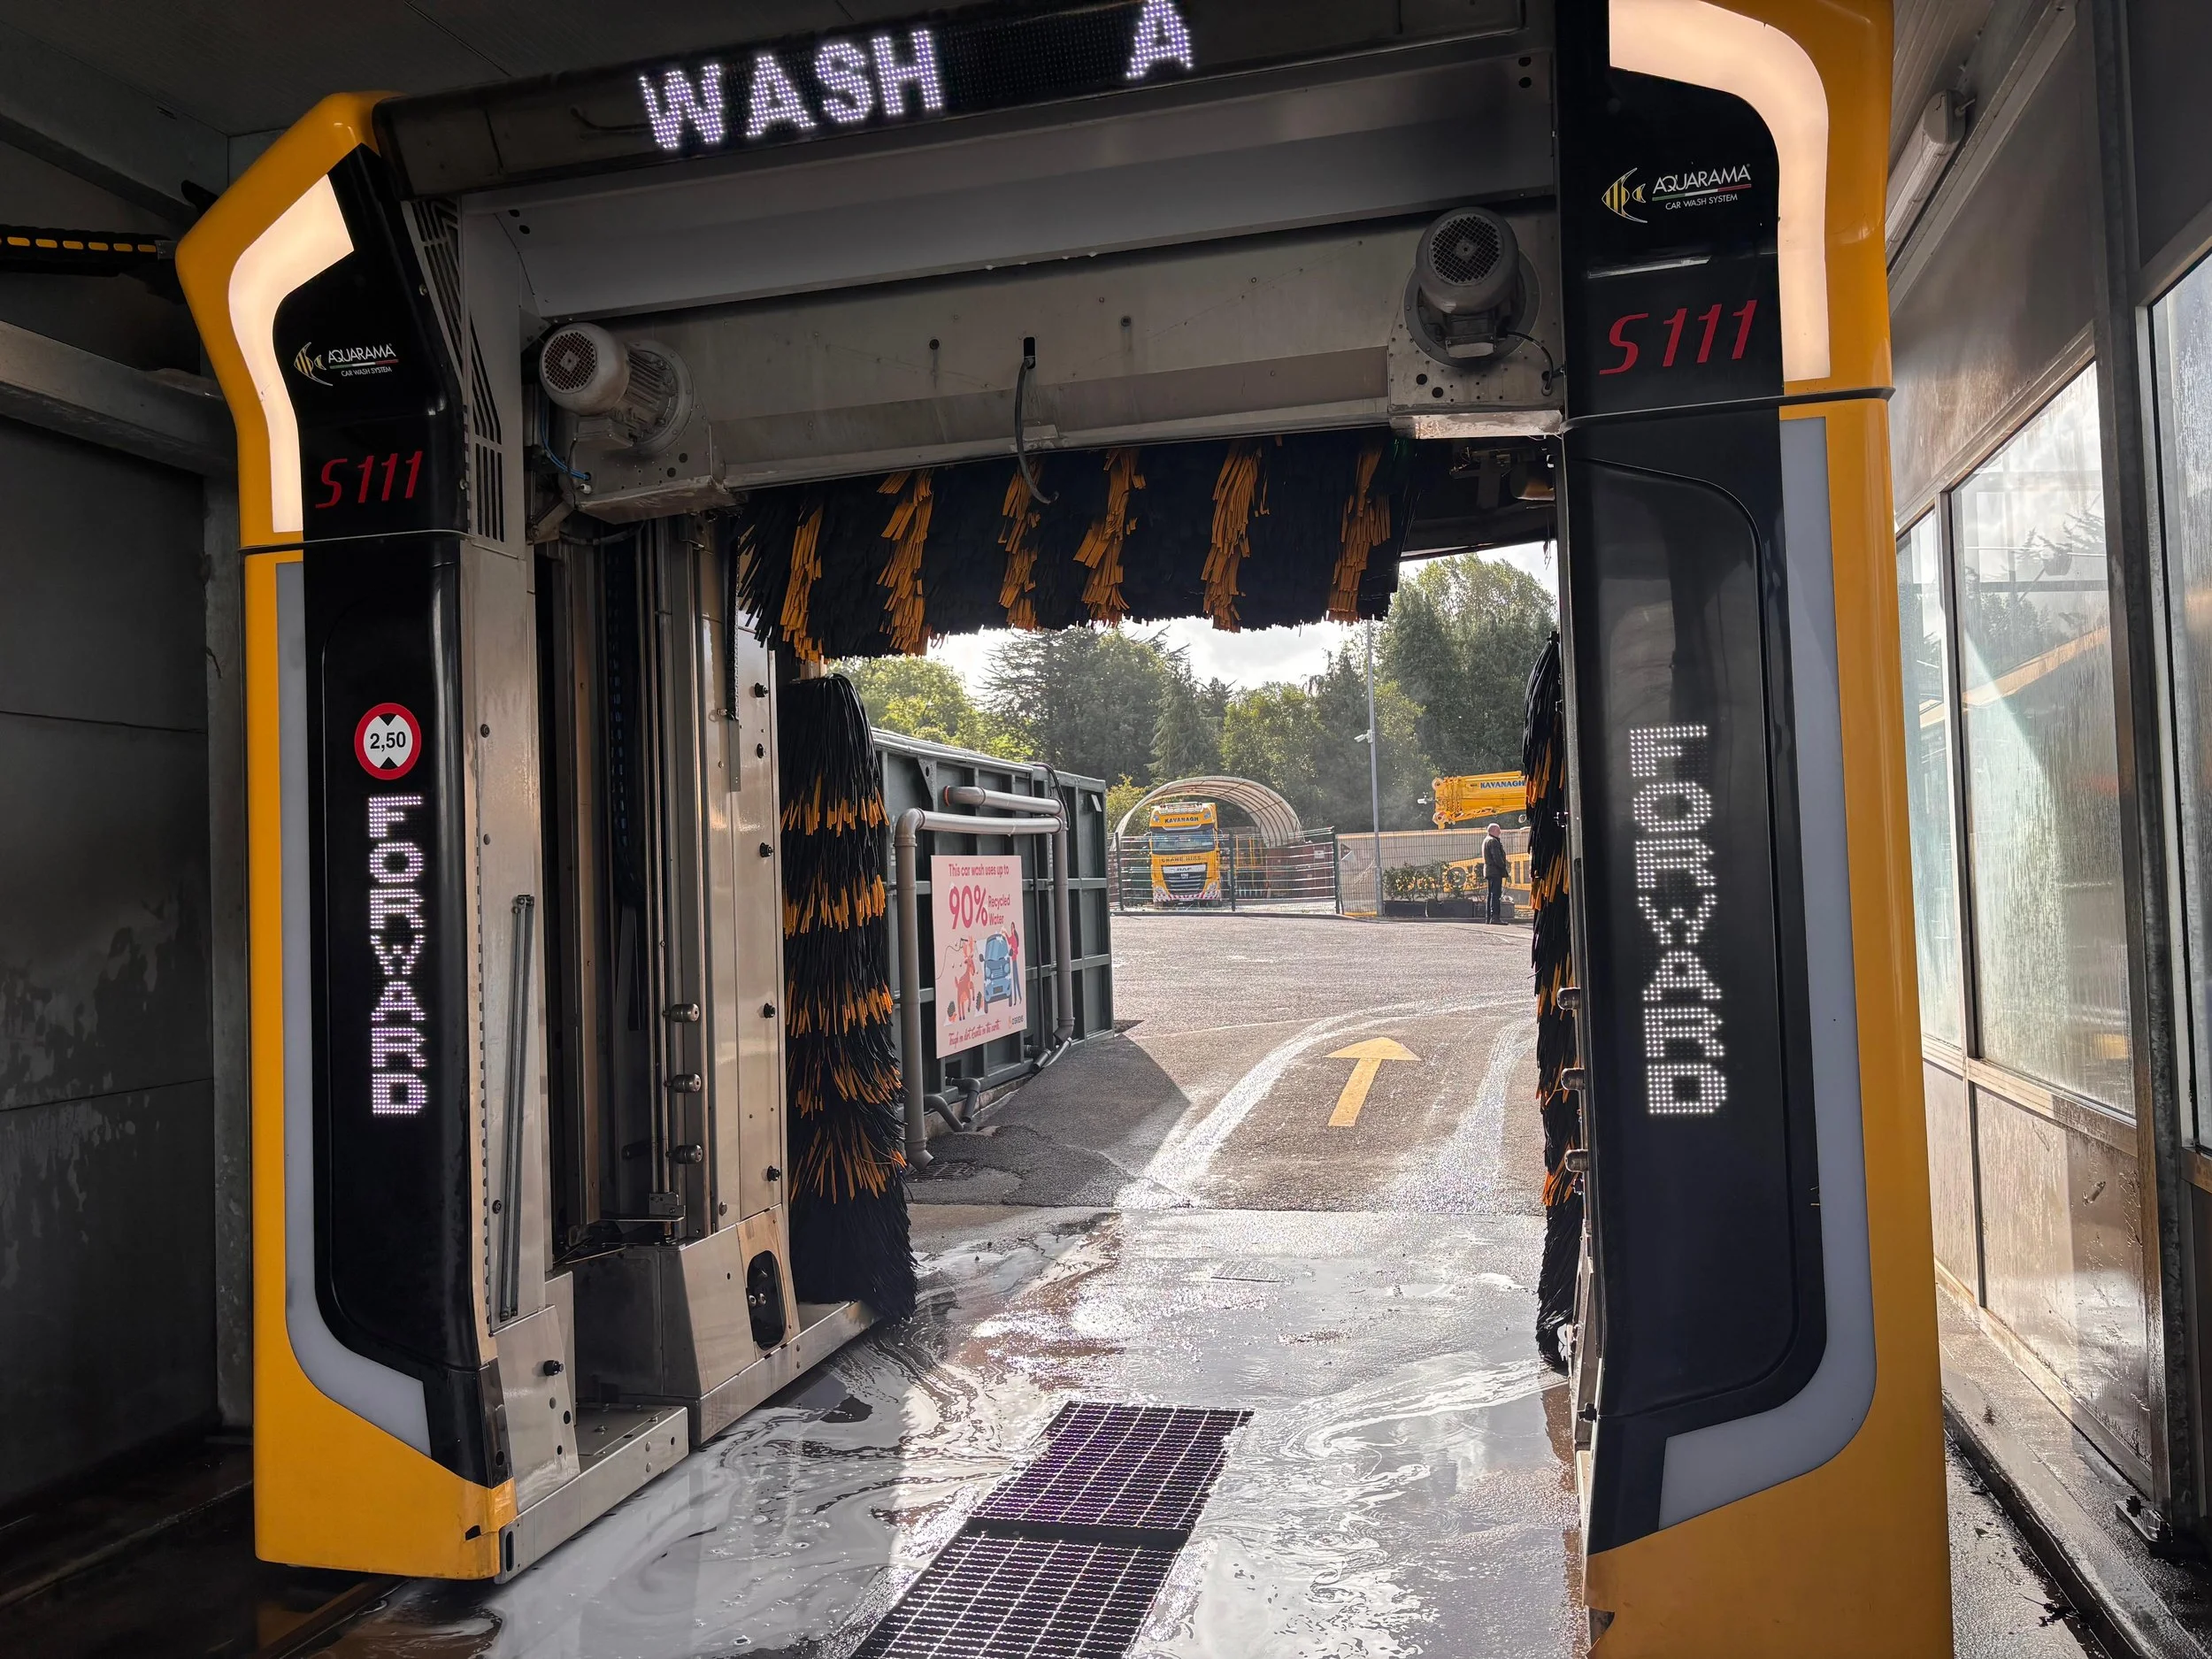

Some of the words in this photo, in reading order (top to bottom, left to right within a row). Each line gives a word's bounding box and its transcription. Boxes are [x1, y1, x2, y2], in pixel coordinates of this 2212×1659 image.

[639, 29, 943, 150] WASH
[1125, 0, 1194, 79] A
[1653, 165, 1751, 194] AQUARAMA
[1665, 202, 1681, 211] CAR
[1684, 197, 1707, 208] WASH
[1709, 193, 1738, 204] SYSTEM
[328, 343, 396, 364] AQUARAMA
[353, 367, 371, 376] WASH
[372, 365, 392, 374] SYSTEM
[370, 731, 406, 753] 2,50
[1480, 780, 1525, 788] KAVANAGH
[949, 864, 960, 876] This
[961, 866, 971, 876] car
[972, 864, 985, 876] wash
[986, 866, 996, 875] uses
[997, 865, 1003, 878] up
[1004, 864, 1010, 875] to
[949, 885, 988, 930] 90%
[987, 894, 1010, 910] Recycled
[988, 913, 1004, 926] Water
[1629, 724, 1727, 1115] FORWARD
[368, 795, 427, 1115] FORWARD
